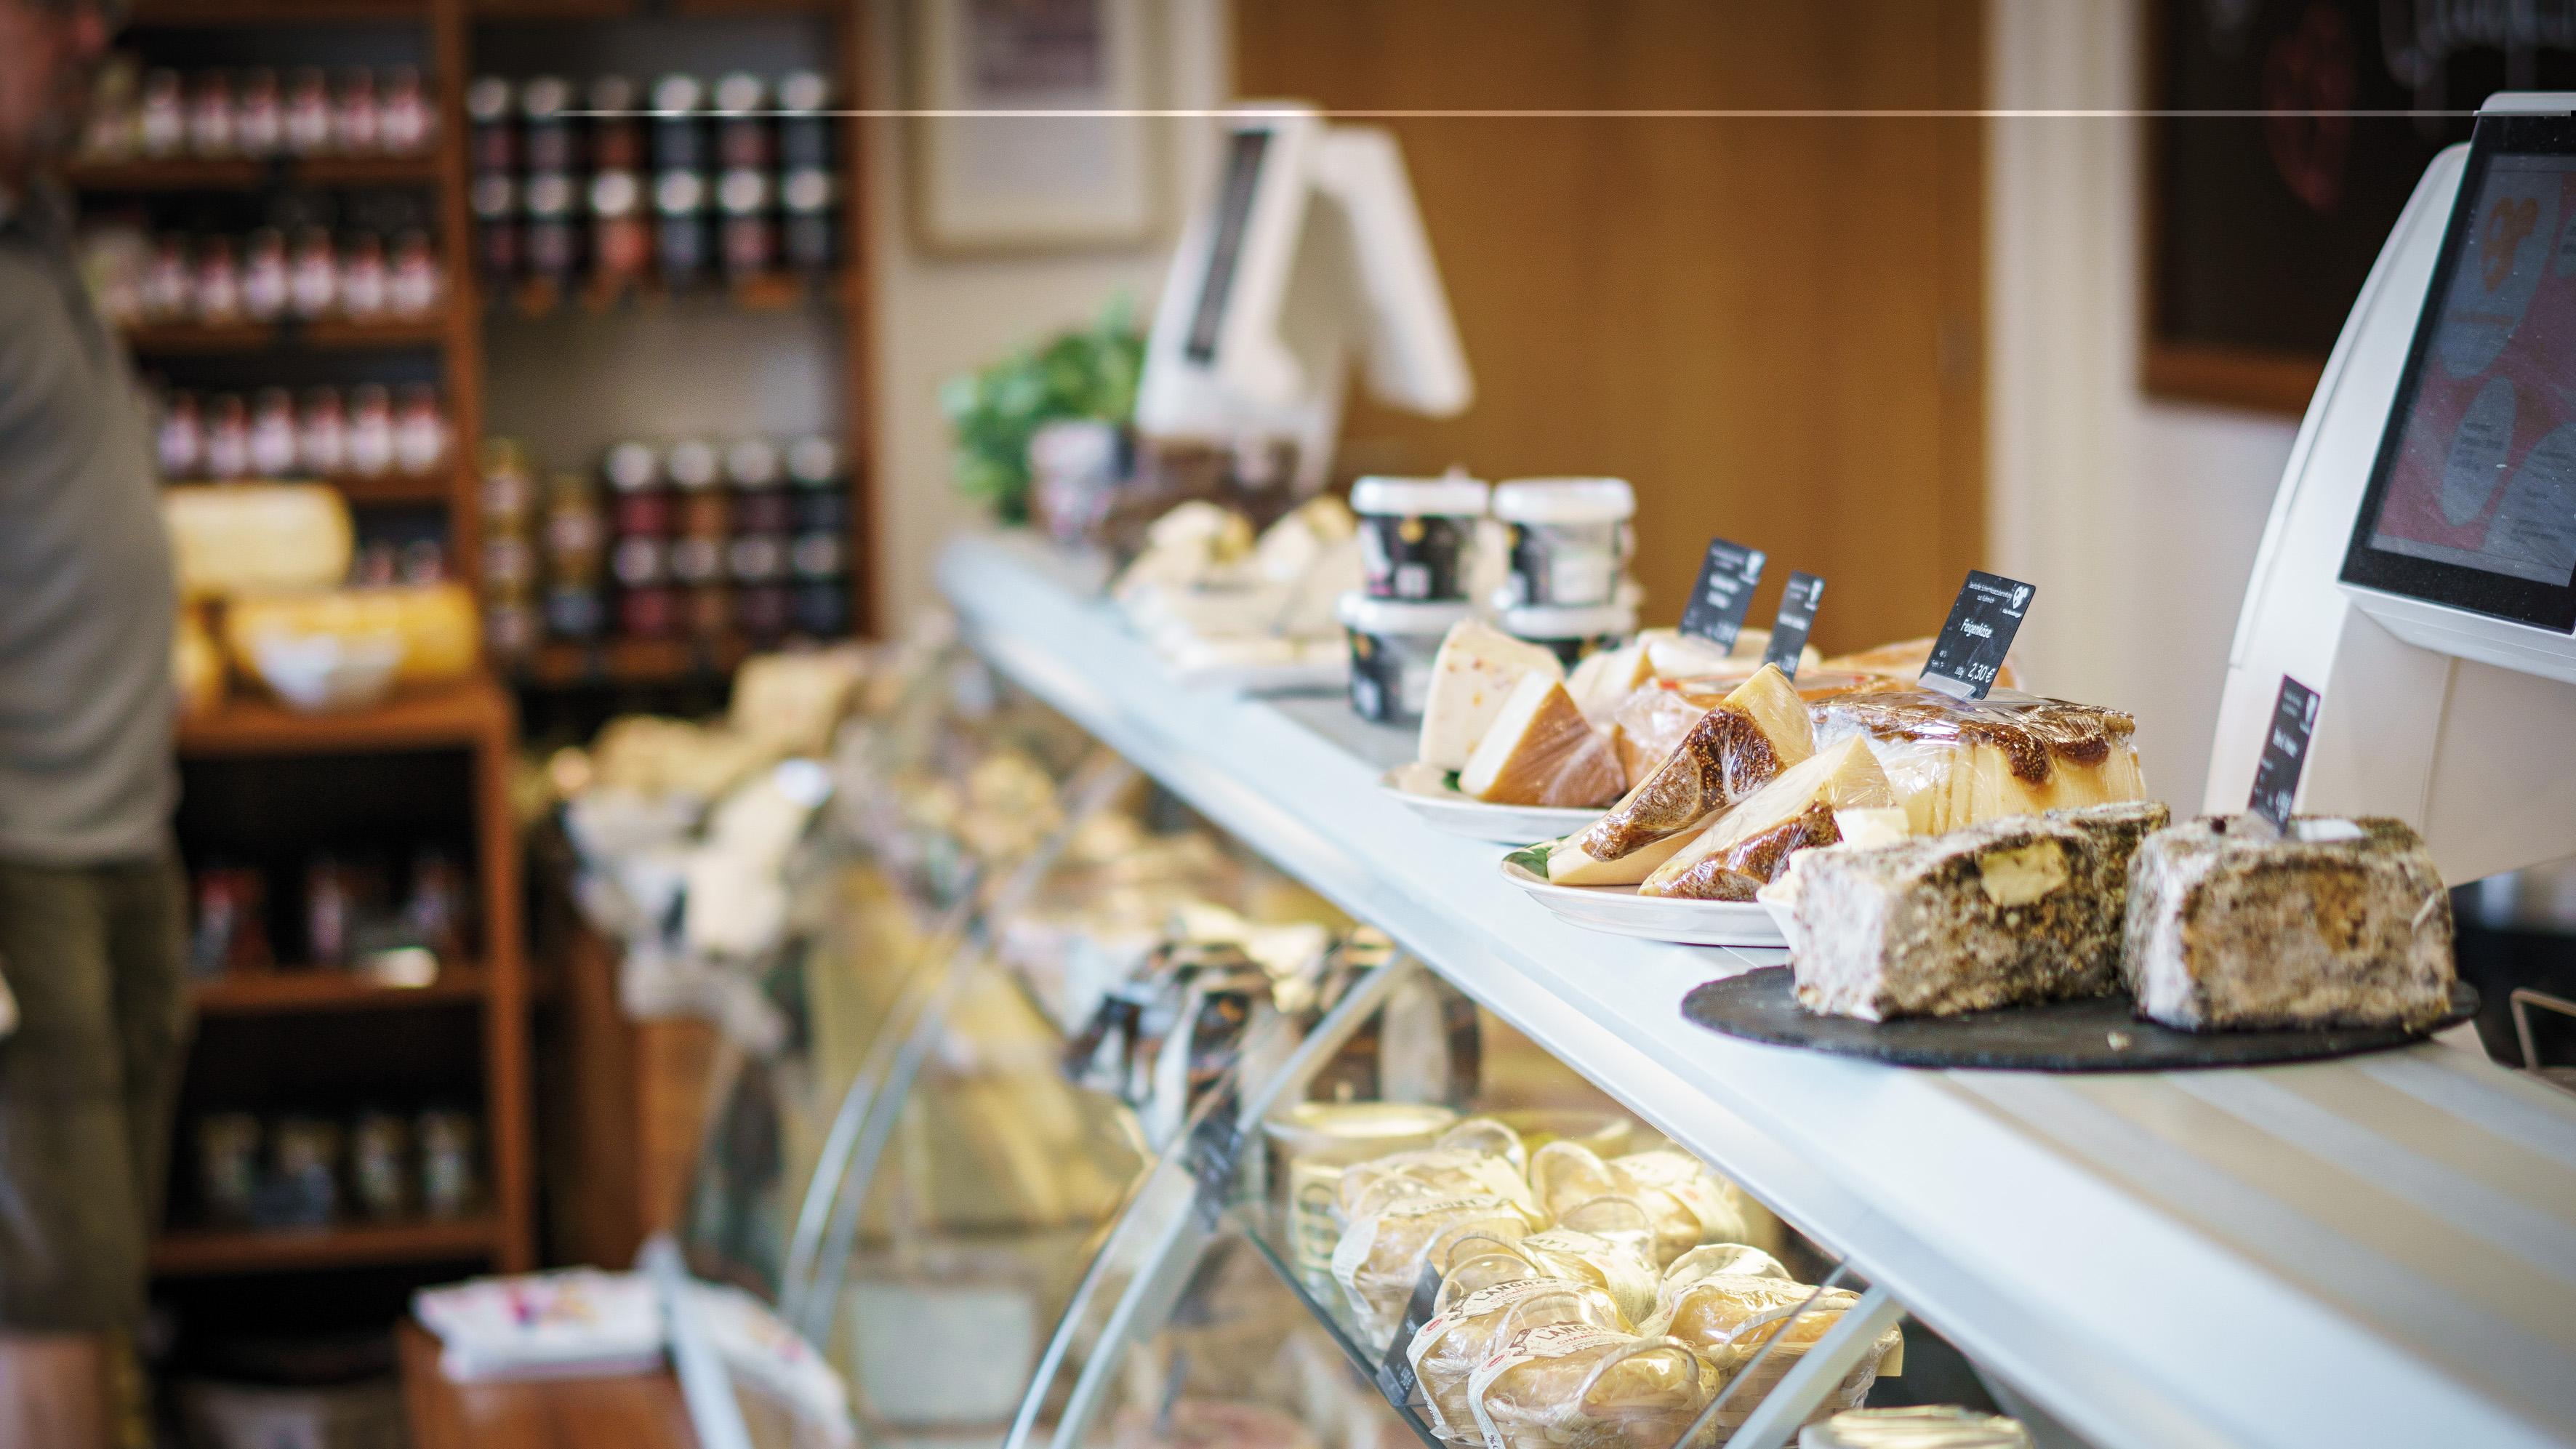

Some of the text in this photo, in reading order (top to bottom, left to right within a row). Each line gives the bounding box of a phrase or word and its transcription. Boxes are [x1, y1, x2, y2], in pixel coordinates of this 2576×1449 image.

[1960, 618, 1992, 638] Feigenkäse
[1967, 662, 1988, 681] 2,30
[1986, 668, 1996, 683] €
